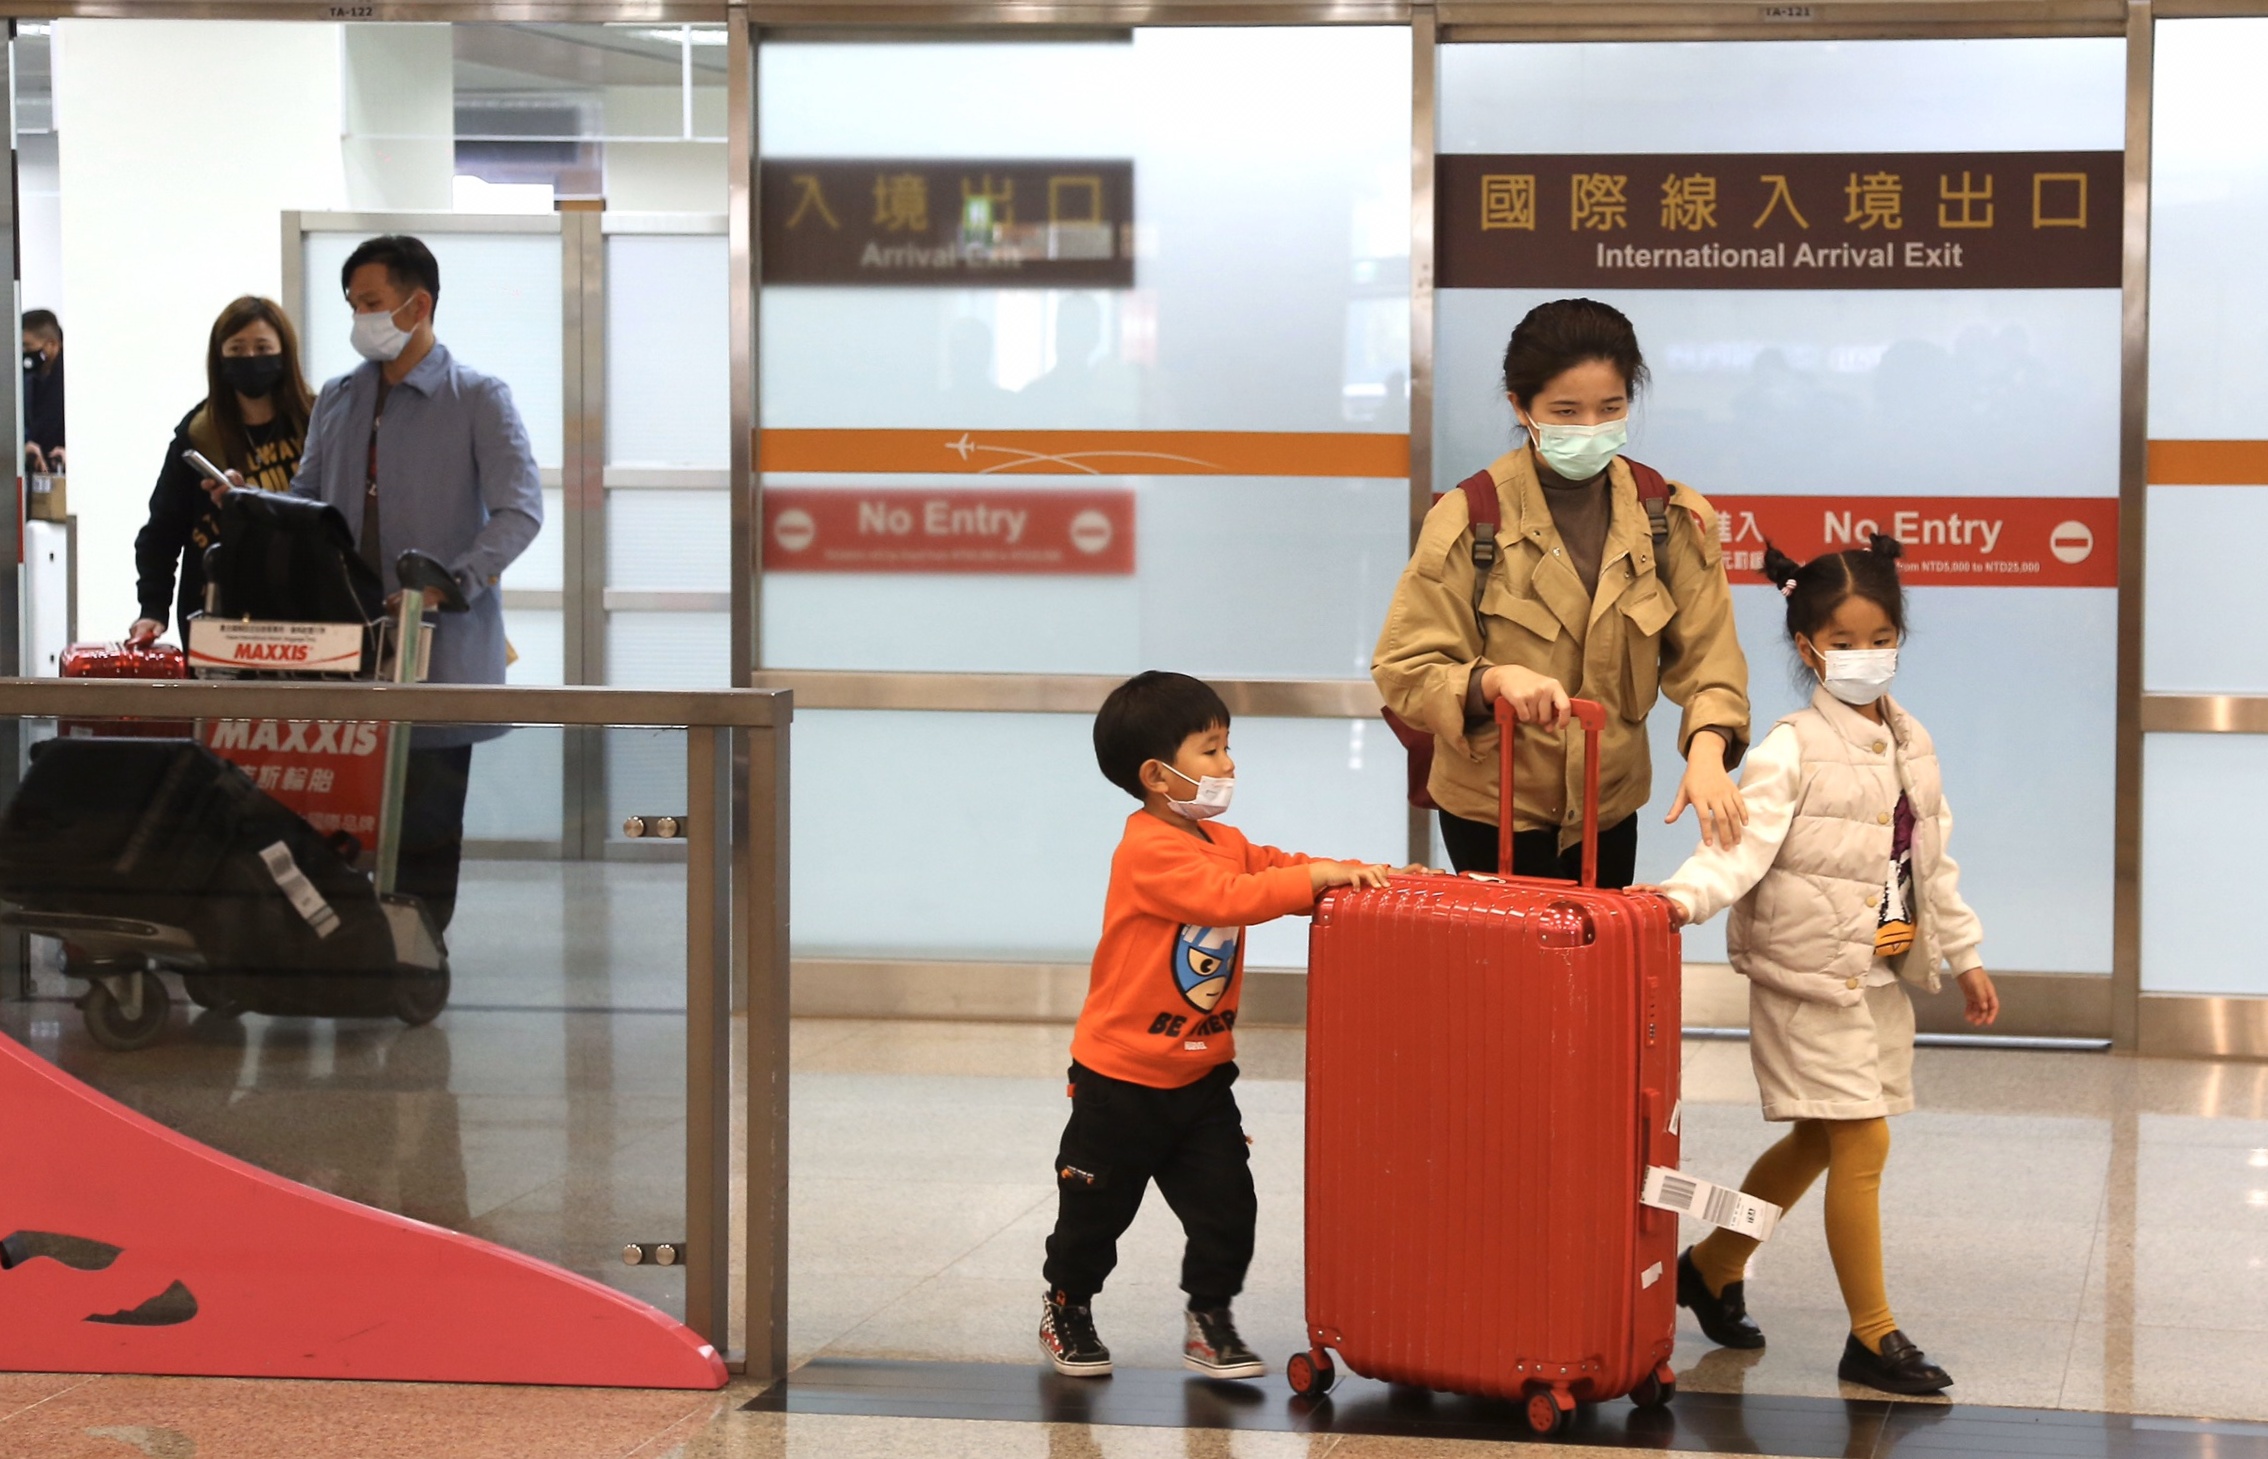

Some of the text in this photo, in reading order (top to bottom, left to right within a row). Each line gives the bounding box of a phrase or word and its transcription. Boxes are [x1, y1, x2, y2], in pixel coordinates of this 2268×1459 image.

[330, 7, 373, 17] TA-122
[786, 174, 1102, 232] 入境出口
[1480, 171, 2088, 232] 國際線入境出口
[860, 242, 956, 268] Arrival
[1596, 242, 1963, 269] International Arrival Exit
[858, 500, 1028, 543] No Entry
[1824, 510, 2004, 553] No Entry
[1921, 561, 1970, 573] NTD5,000
[1972, 561, 1984, 572] to
[1985, 562, 2041, 574] NTD25,000
[234, 643, 309, 661] MAXXIS
[211, 722, 378, 756] MAXXIS
[1147, 1012, 1187, 1037] BE
